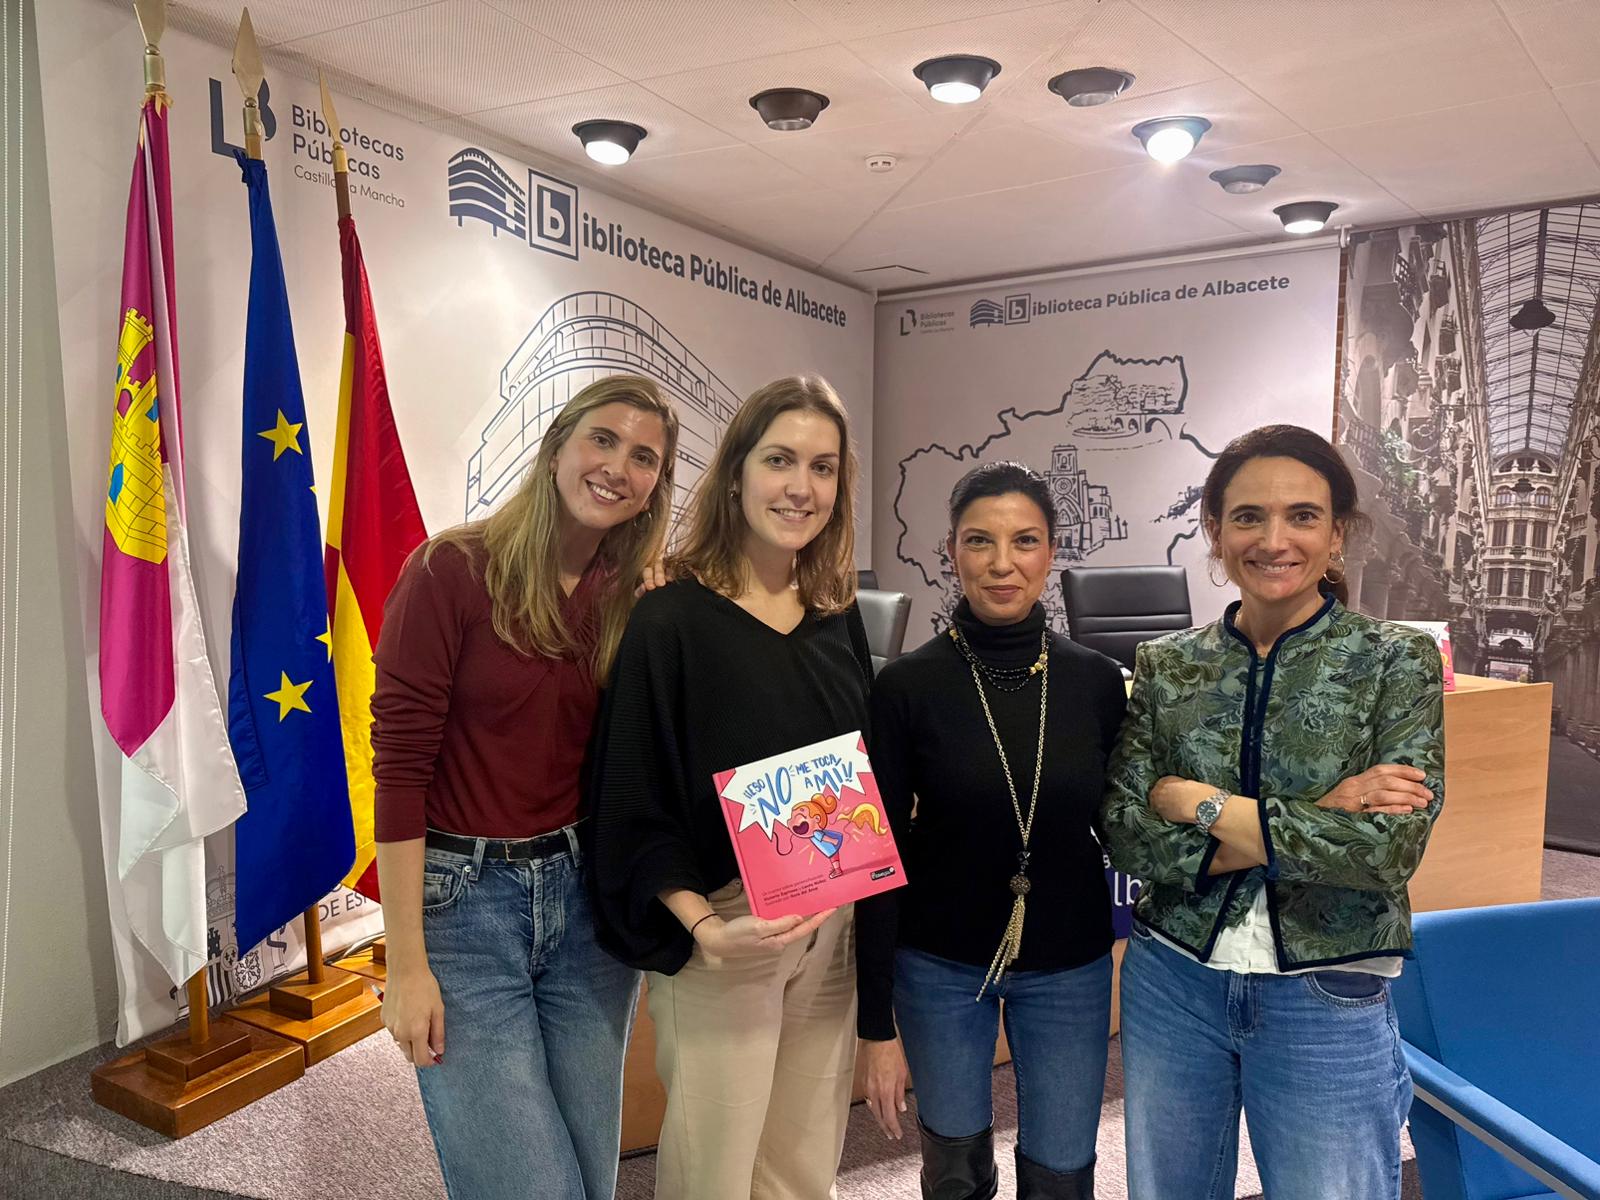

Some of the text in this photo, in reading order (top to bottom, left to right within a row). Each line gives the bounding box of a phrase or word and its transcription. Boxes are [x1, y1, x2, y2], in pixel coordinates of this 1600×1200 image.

[292, 104, 405, 161] Bibotecas
[293, 133, 381, 180] Púbcas
[360, 184, 405, 208] Mancha
[690, 253, 758, 301] Pública
[761, 279, 782, 308] de
[785, 288, 847, 328] Albacete
[1106, 288, 1171, 308] Pública
[1175, 284, 1198, 300] de
[1202, 275, 1290, 298] Albacete
[757, 766, 792, 828] NO
[795, 761, 811, 775] ME
[811, 753, 837, 769] TOCA
[804, 776, 814, 789] A
[318, 898, 340, 922] DE
